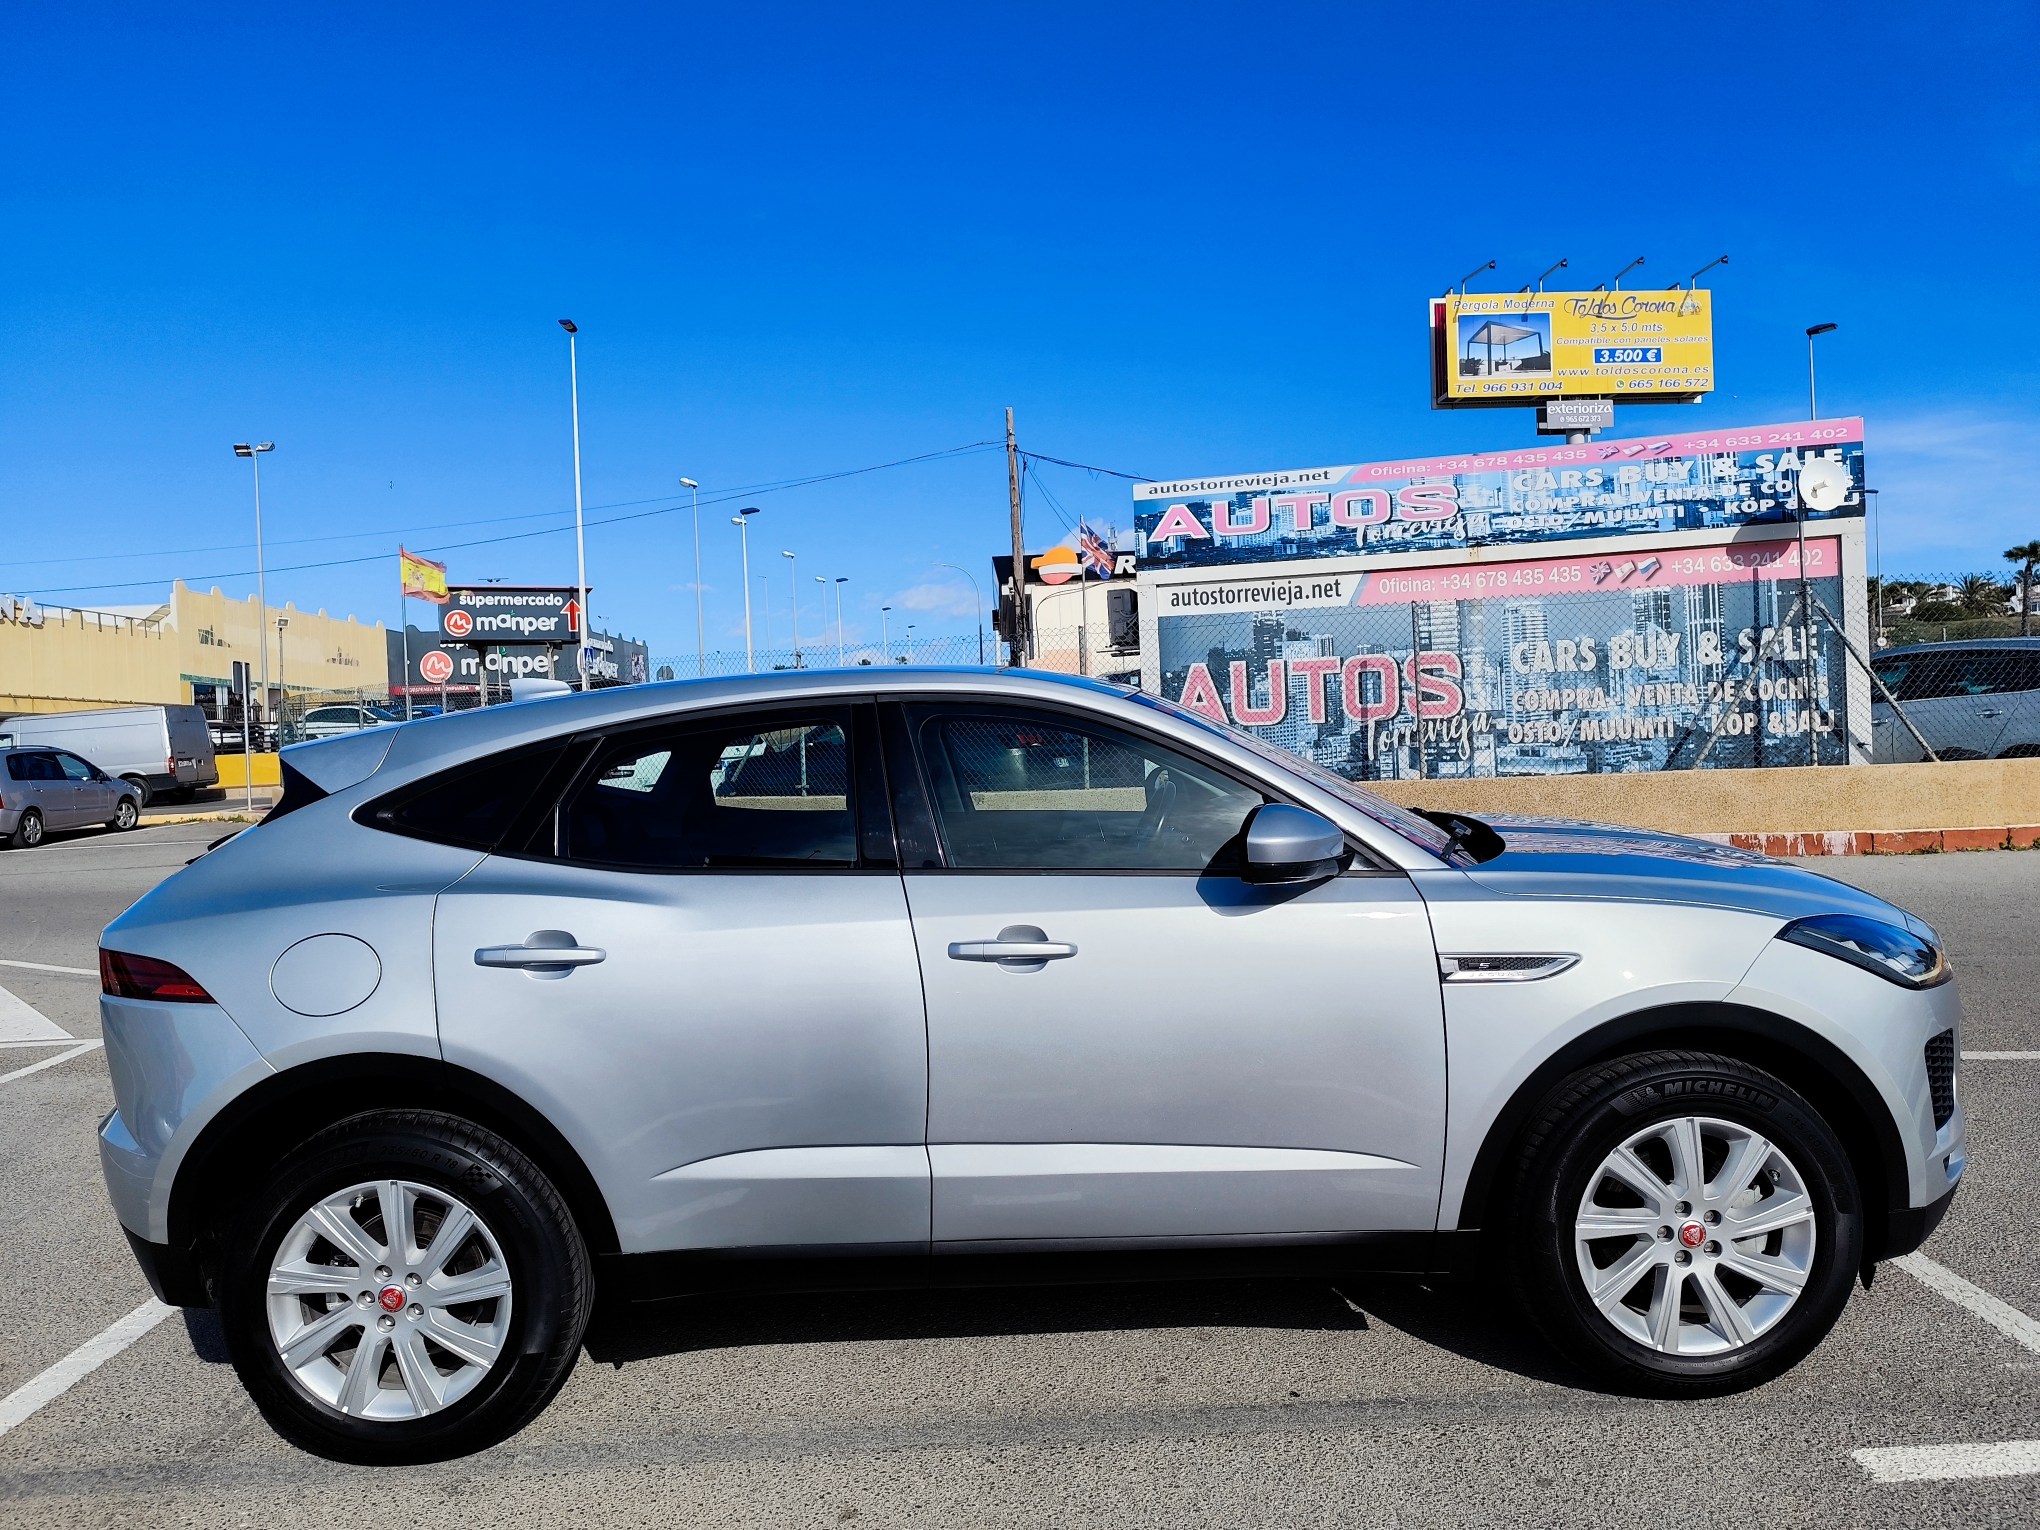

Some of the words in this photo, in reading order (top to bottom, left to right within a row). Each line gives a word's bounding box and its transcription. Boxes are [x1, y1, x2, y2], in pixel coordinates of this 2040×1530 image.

[1503, 298, 1555, 309] Moderna
[1621, 295, 1676, 315] Corona
[1590, 323, 1607, 333] 3,5
[1620, 322, 1638, 333] 5,0
[1641, 322, 1666, 332] mts.
[1556, 335, 1611, 345] Compatible
[1674, 335, 1709, 343] solares
[1599, 349, 1643, 363] 3.500
[1646, 349, 1658, 362] €
[1557, 366, 1709, 376] www.toldoscorona.es
[1455, 384, 1478, 393] Tel.
[1482, 383, 1507, 393] 966
[1511, 382, 1534, 392] 931
[1538, 381, 1563, 391] 004
[1628, 379, 1654, 389] 665
[1658, 379, 1685, 388] 166
[1684, 378, 1709, 388] 572
[1547, 402, 1613, 414] exterioriza
[1565, 415, 1578, 423] 965
[1578, 415, 1590, 423] 672
[1684, 438, 1720, 450] +34
[1725, 435, 1763, 447] 633
[1767, 431, 1805, 444] 241
[1809, 427, 1848, 440] 402
[1370, 463, 1431, 477] Oficina:
[1436, 460, 1470, 471] +34
[1473, 456, 1508, 469] 678
[1512, 453, 1548, 465] 435
[1552, 450, 1588, 462] 435
[1512, 467, 1604, 492] CARS
[1618, 460, 1695, 485] BUY
[1712, 457, 1740, 478] &
[1148, 469, 1331, 496] autostorrevieja.net
[1511, 492, 1615, 514] COMPRA
[1637, 485, 1714, 504] VENTA
[1721, 482, 1752, 497] DE
[1724, 496, 1776, 515] KÖP
[1148, 484, 1461, 543] AUTOS
[1114, 555, 1137, 575] R
[1671, 556, 1706, 574] +34
[1710, 553, 1745, 572] 633
[1750, 550, 1784, 569] 241
[1788, 547, 1823, 566] 402
[1378, 576, 1436, 595] Oficina:
[1440, 572, 1472, 590] +34
[1475, 570, 1508, 588] 678
[1511, 568, 1545, 586] 435
[1548, 565, 1582, 583] 435
[458, 593, 564, 609] supermercado
[1170, 578, 1342, 608] autostorrevieja.net
[475, 612, 559, 636] manper
[1512, 636, 1598, 675] CARS
[1609, 631, 1682, 670] BUY
[1696, 630, 1725, 666] &
[1738, 624, 1819, 664] SALE
[1179, 649, 1465, 726] AUTOS
[1511, 685, 1608, 713] COMPRA
[1628, 682, 1700, 707] VENTA
[1707, 679, 1736, 703] DE
[1711, 706, 1759, 736] KÖP
[1362, 709, 1493, 761] Torrevieja
[1664, 1080, 1776, 1112] MICHELIN
